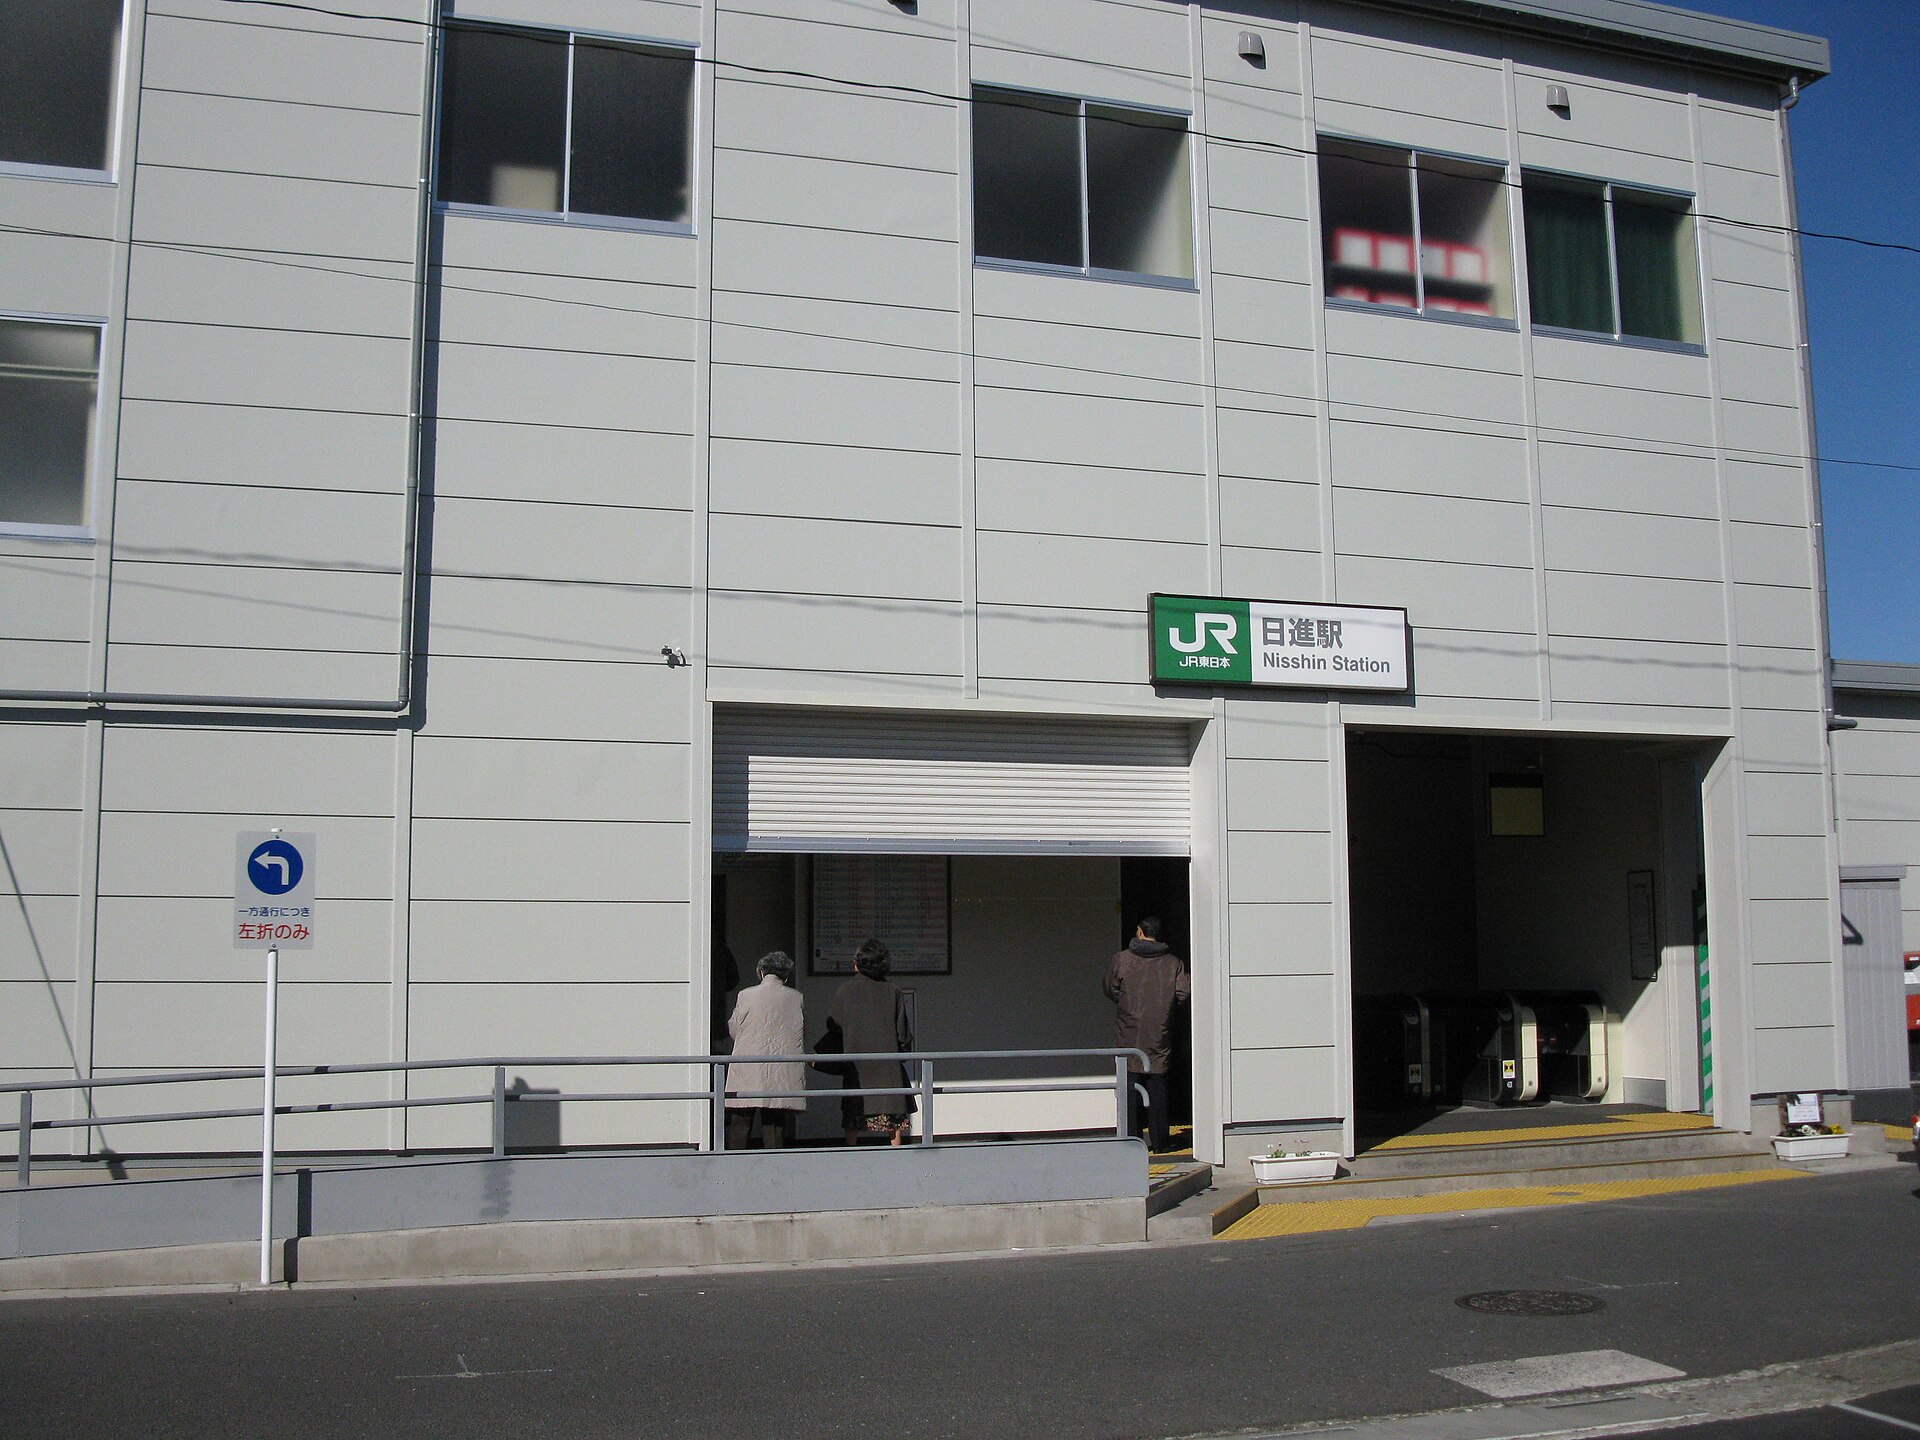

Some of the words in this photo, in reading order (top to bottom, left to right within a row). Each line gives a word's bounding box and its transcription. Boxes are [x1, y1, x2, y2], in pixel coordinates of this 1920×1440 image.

[1168, 612, 1238, 654] JR
[1262, 617, 1343, 649] 日進駅
[1179, 655, 1231, 669] JR東日本
[1263, 652, 1327, 671] Nisshin
[1332, 656, 1390, 673] Station
[238, 906, 310, 917] 一方通行につき
[239, 923, 310, 940] 左折のみ
